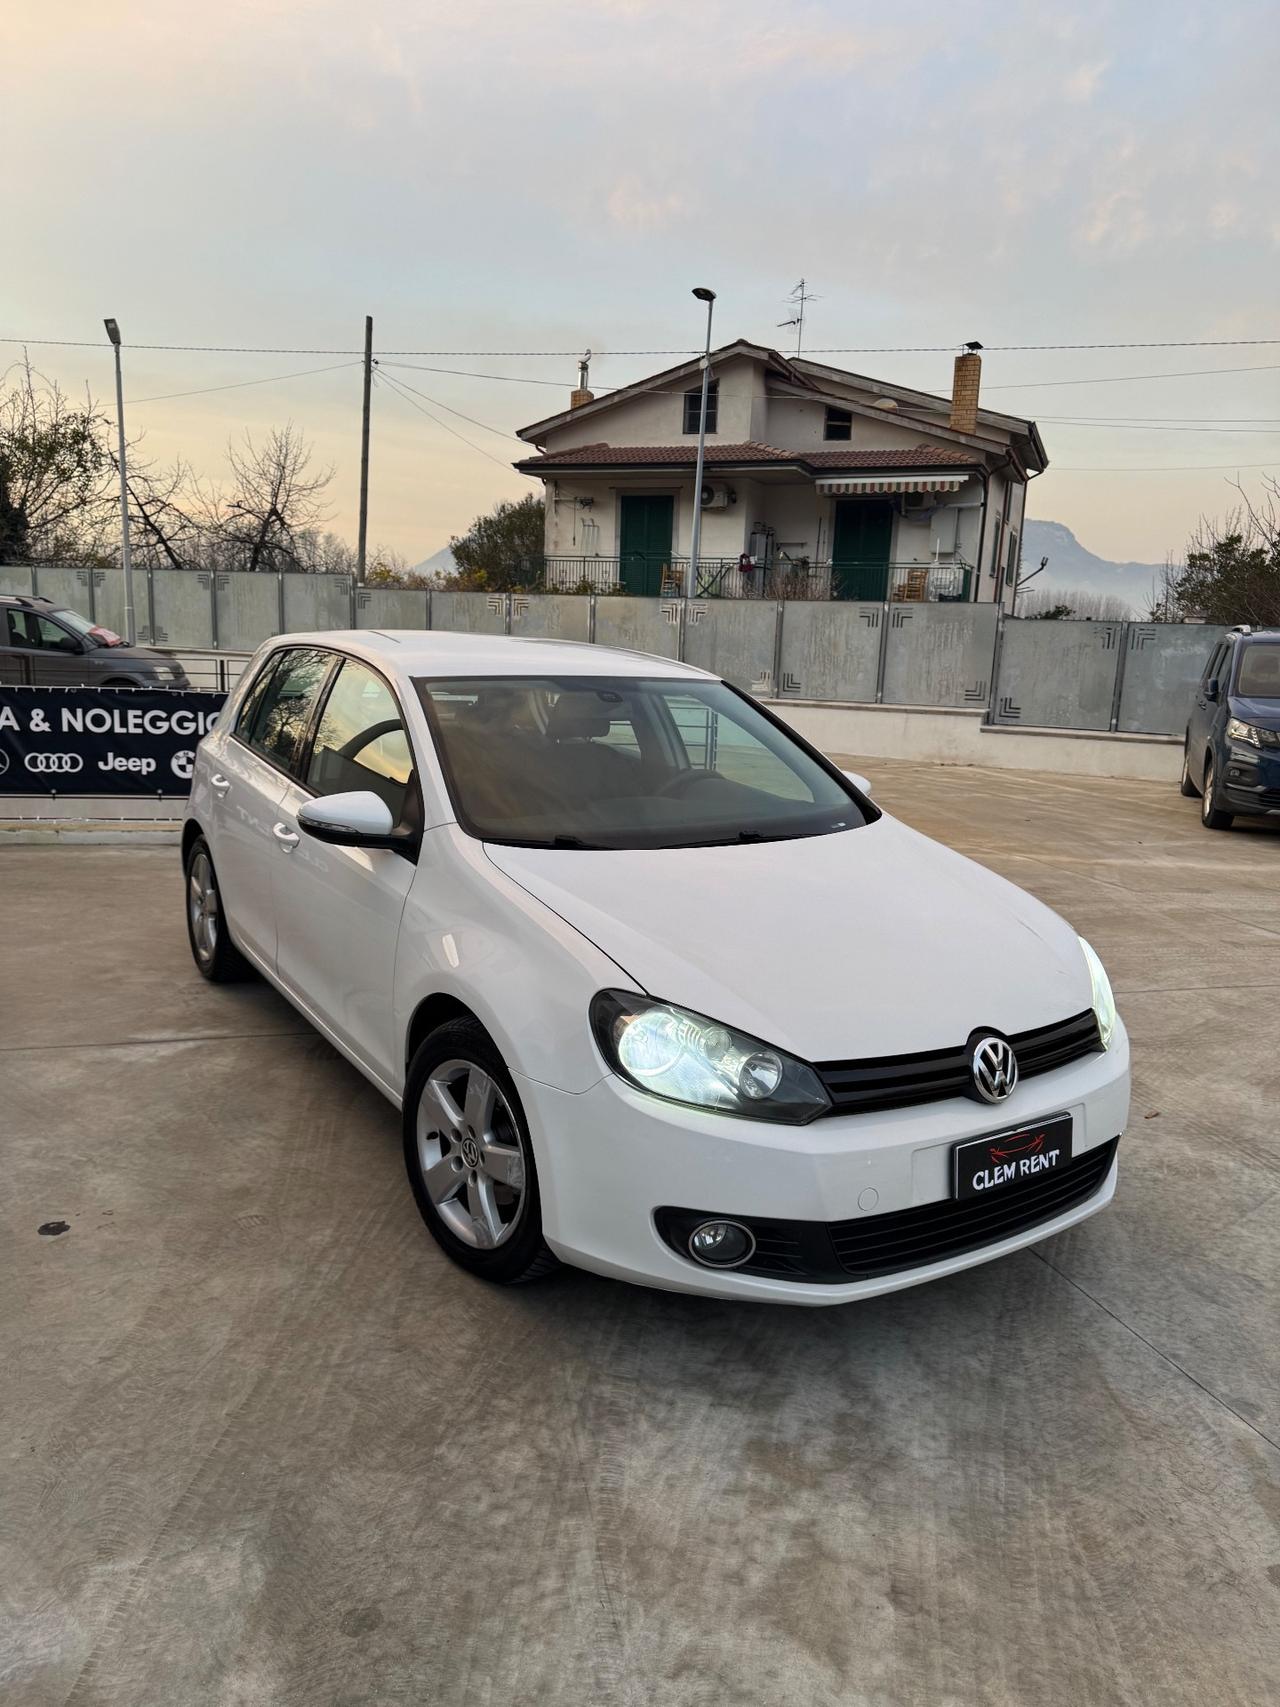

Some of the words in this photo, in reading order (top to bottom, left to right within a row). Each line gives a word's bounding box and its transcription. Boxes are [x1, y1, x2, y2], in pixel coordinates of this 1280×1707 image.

[29, 708, 52, 732] &
[98, 752, 156, 775] Jeep
[973, 1162, 1016, 1190] CLEM
[1020, 1149, 1060, 1176] RENT
